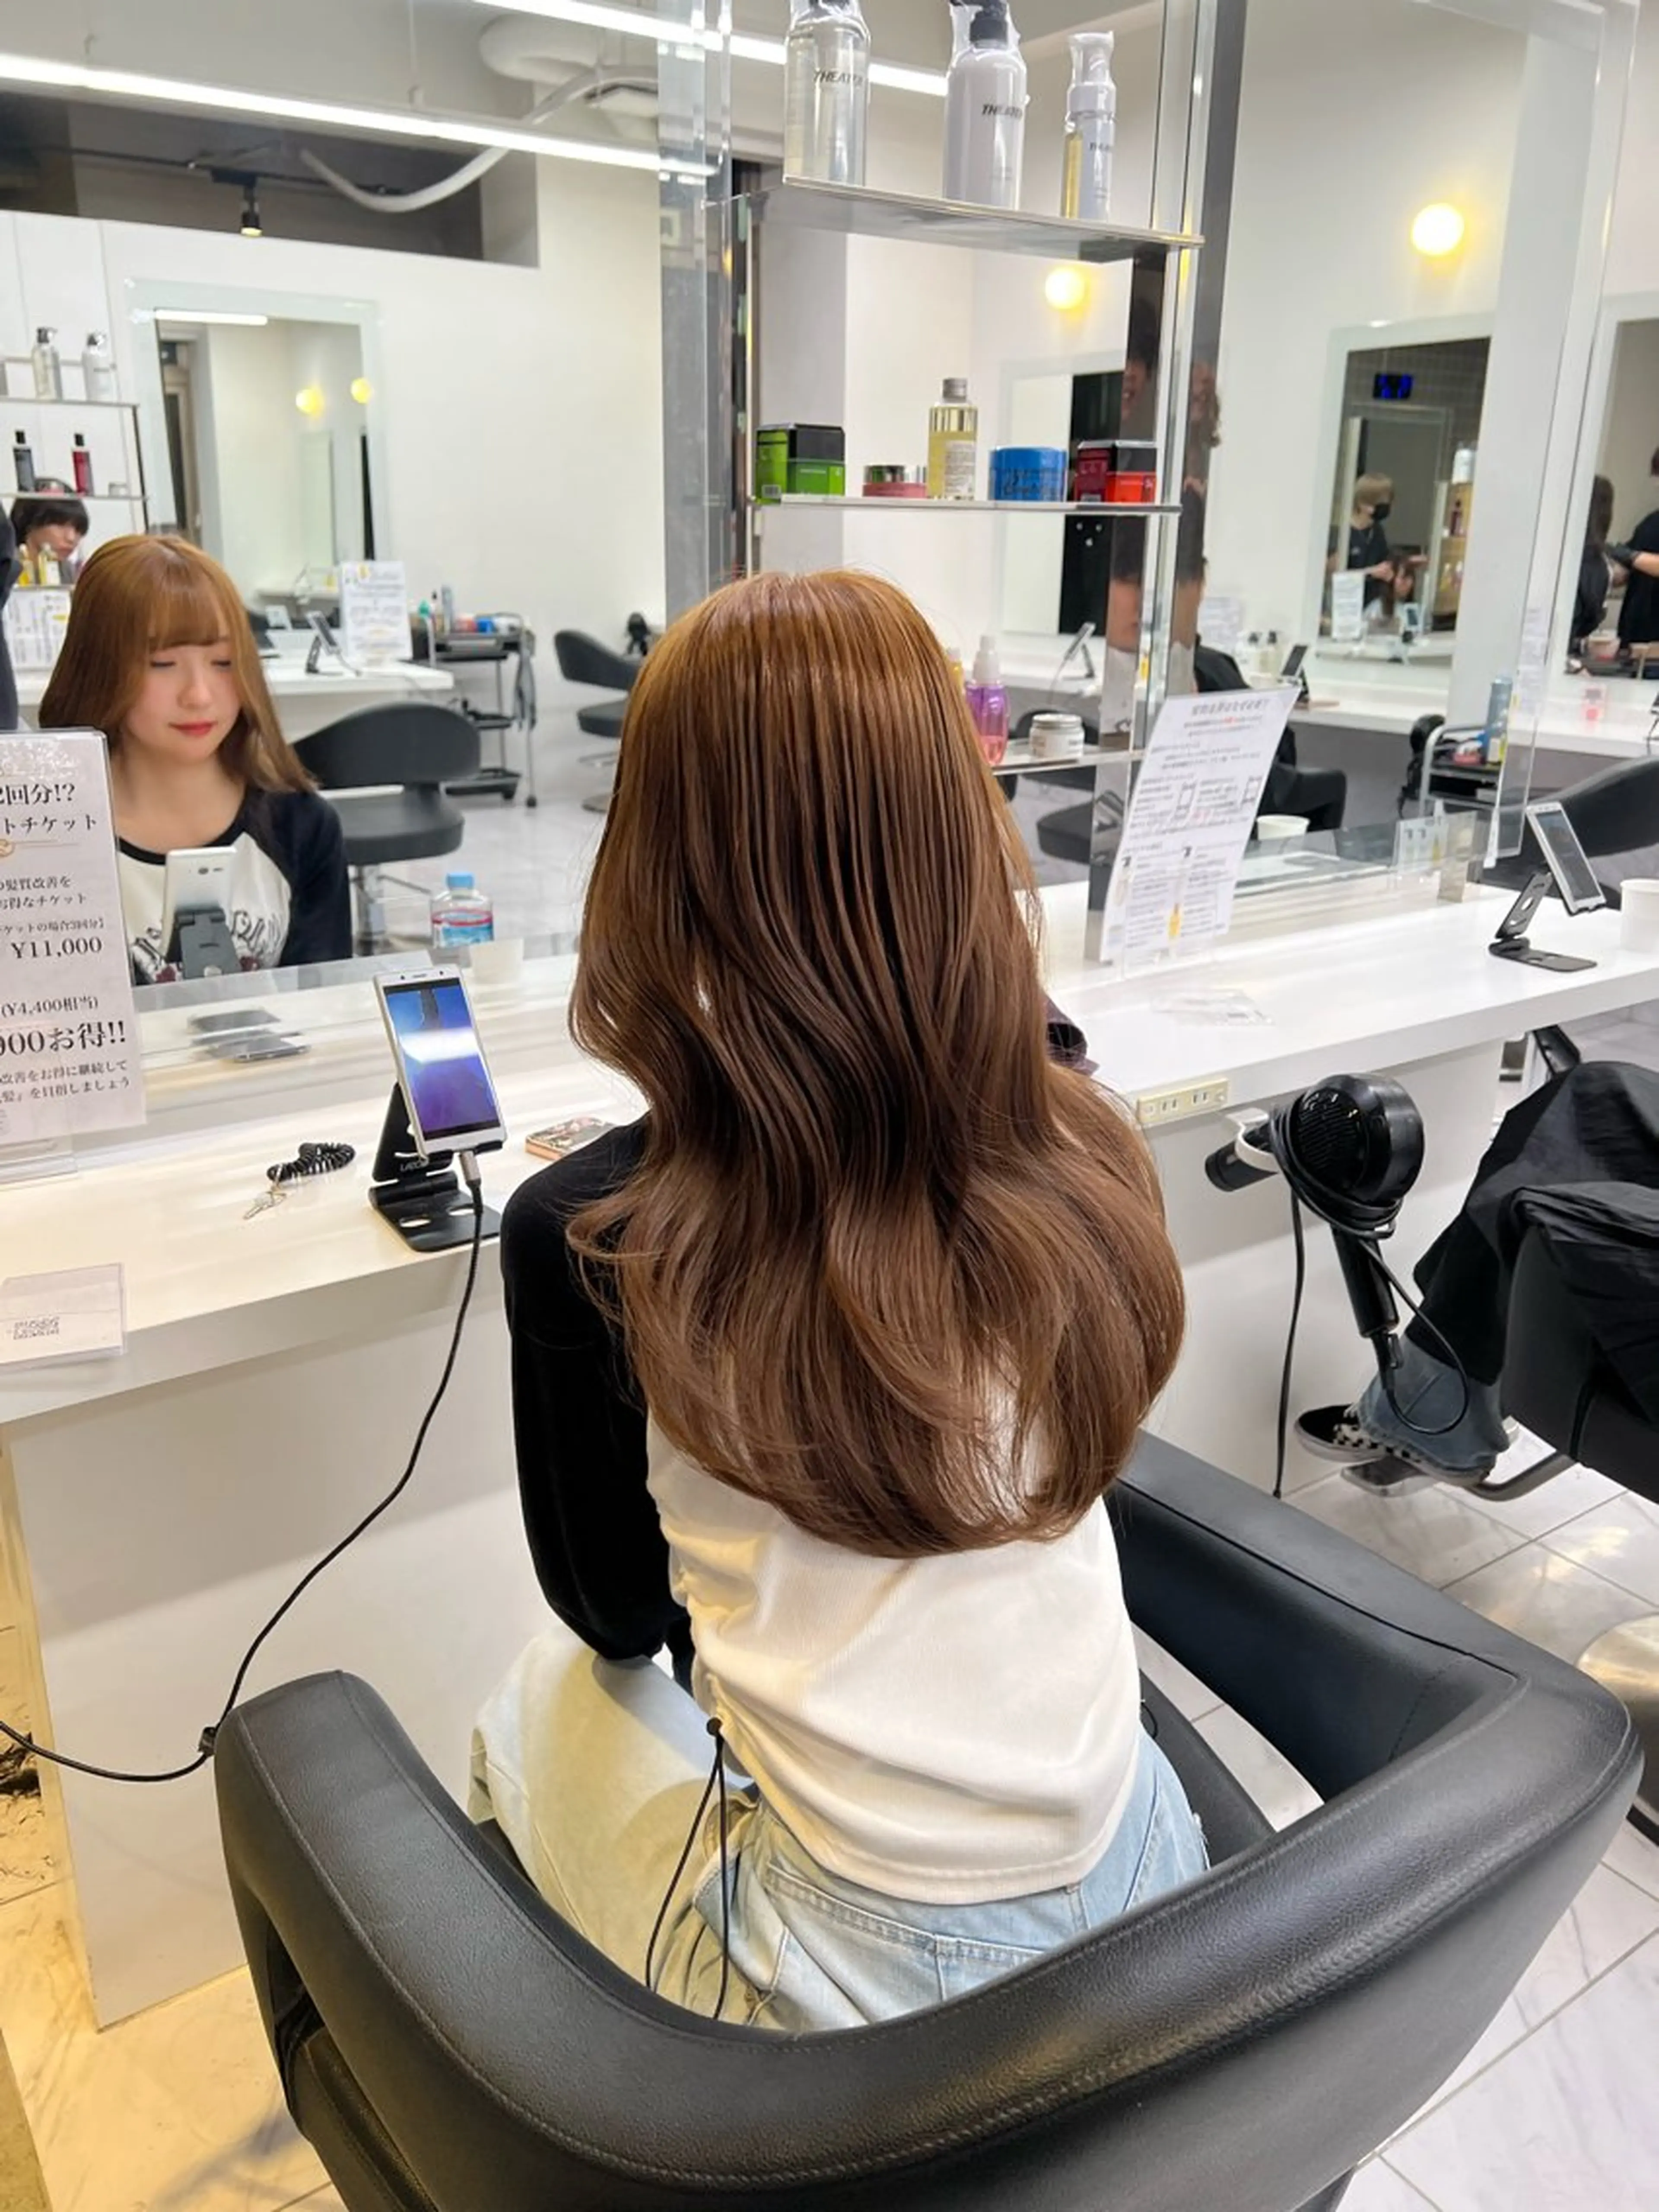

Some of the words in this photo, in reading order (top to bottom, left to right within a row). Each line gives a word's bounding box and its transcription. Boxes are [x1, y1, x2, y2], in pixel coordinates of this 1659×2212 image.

[11, 936, 102, 959] ¥11,000
[0, 1060, 127, 1086] 改善をお得に継続して
